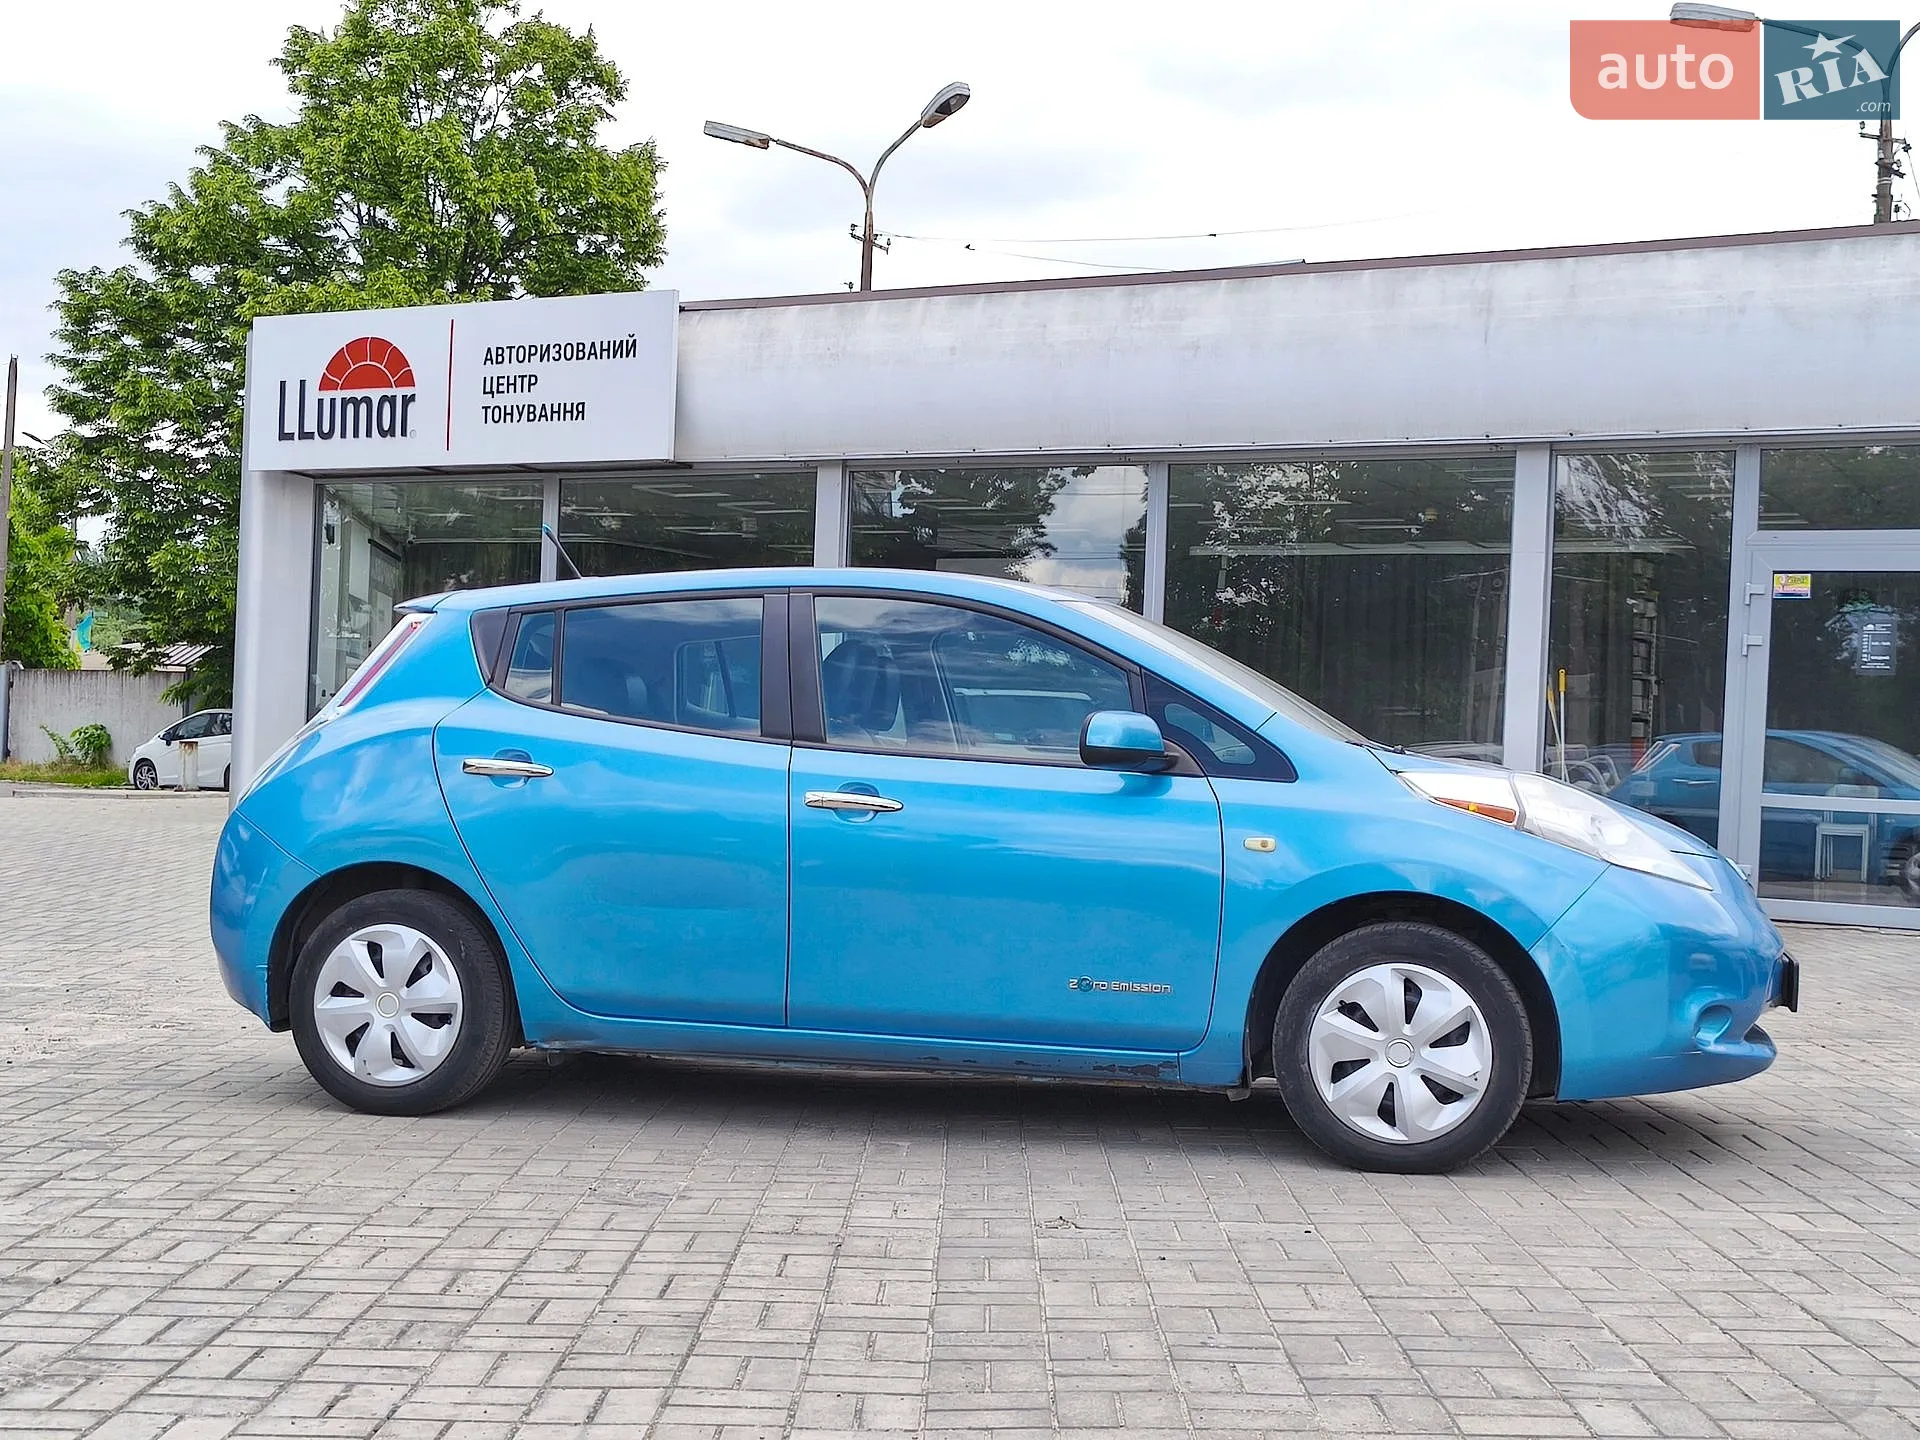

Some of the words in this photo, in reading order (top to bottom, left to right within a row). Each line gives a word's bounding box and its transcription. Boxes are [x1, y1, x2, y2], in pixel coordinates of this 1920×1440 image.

[483, 333, 638, 366] АВТОРИЗОВАНИЙ
[481, 374, 539, 397] ЦЕНТР
[277, 379, 416, 442] LLumar
[481, 401, 587, 425] ТОНУВАННЯ
